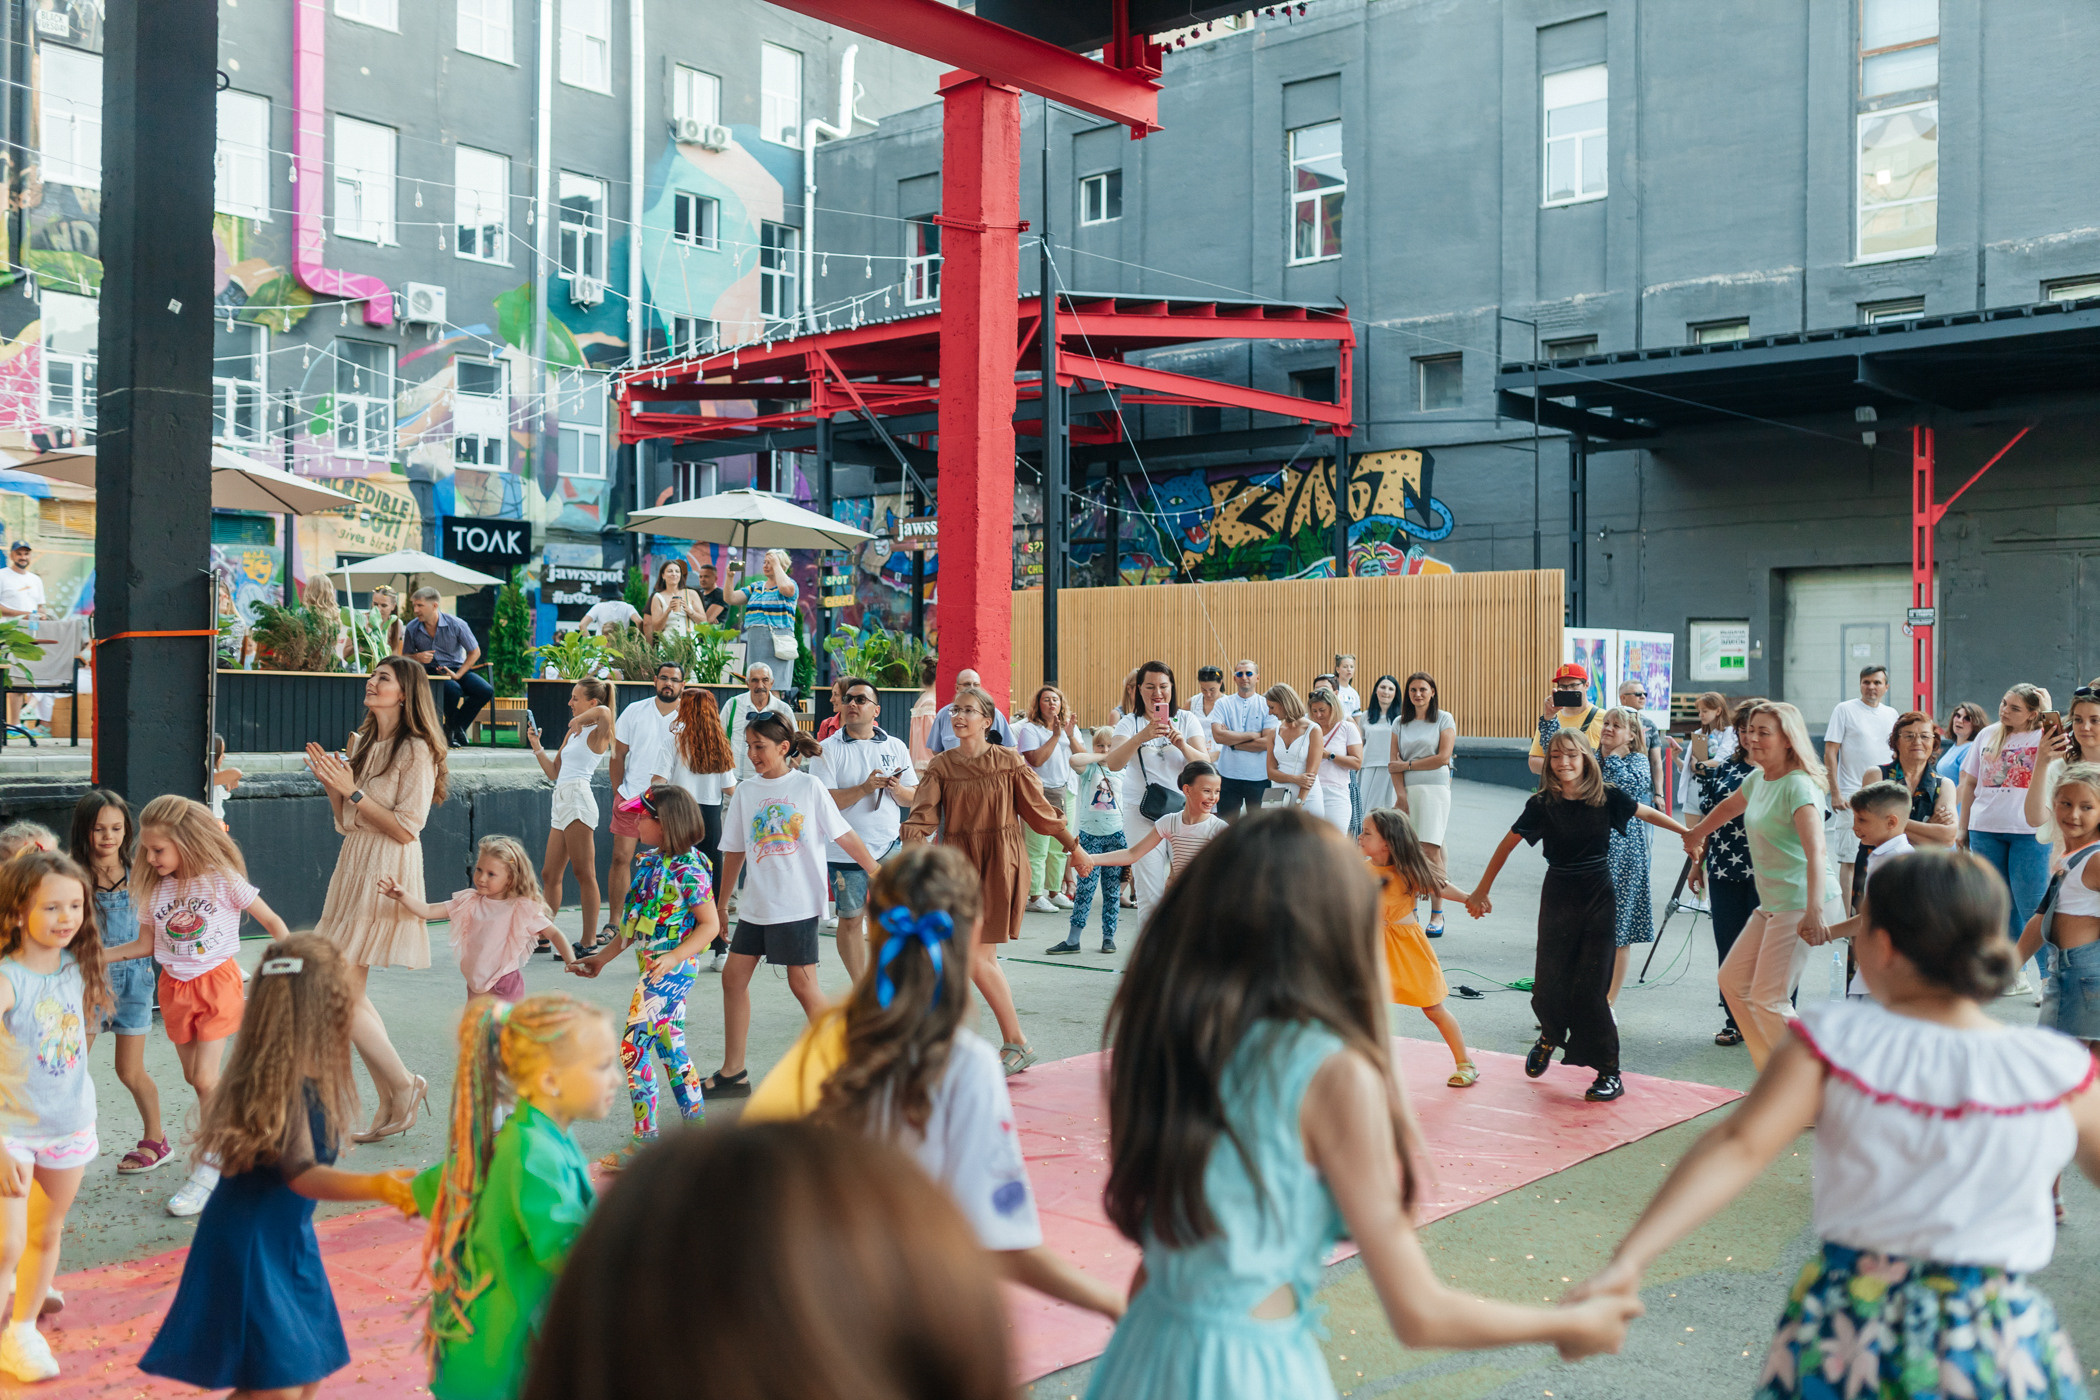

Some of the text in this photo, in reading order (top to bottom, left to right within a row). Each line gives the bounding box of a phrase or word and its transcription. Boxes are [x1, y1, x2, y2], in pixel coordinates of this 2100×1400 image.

[41, 10, 64, 23] BLACK
[312, 478, 410, 519] NCREDIBLE
[338, 528, 366, 544] gives
[452, 526, 523, 555] TOAK
[546, 563, 625, 586] jawsspot
[825, 575, 849, 586] SPOT
[154, 898, 218, 920] READY FOR
